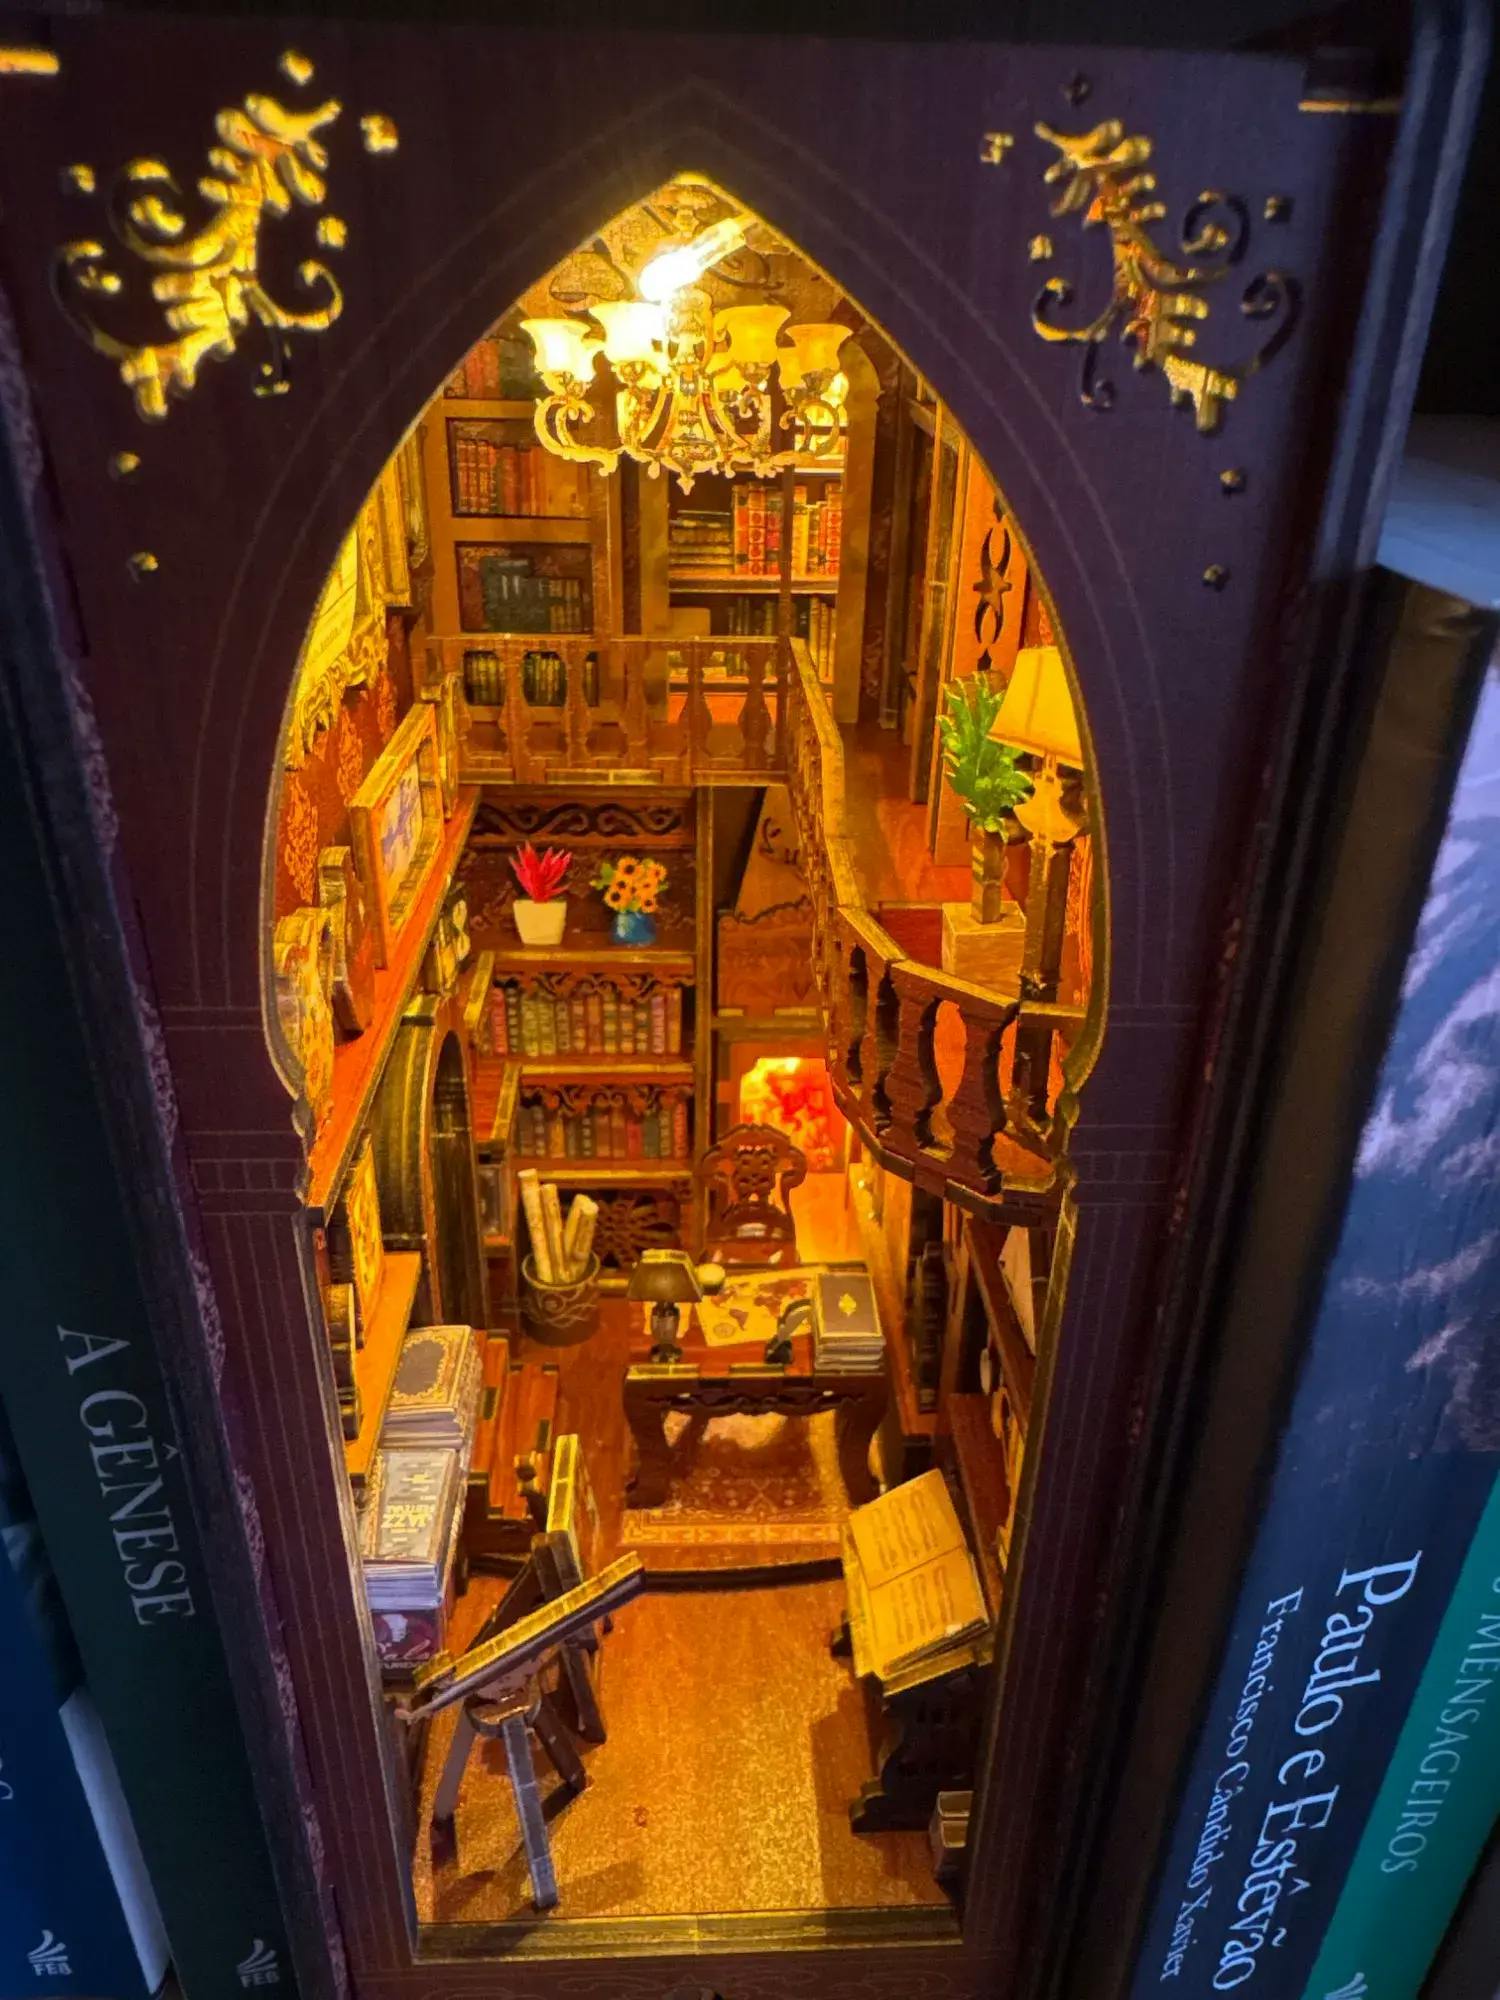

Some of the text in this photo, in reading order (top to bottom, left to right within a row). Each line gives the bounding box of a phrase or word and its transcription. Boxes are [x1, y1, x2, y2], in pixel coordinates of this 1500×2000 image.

[57, 1324, 194, 1625] A GÊNESE
[1226, 1586, 1303, 1759] Francisco
[1380, 1612, 1500, 1875] MENSAGEIROS
[1212, 1550, 1423, 1992] Paulo e Estêvão
[33, 1962, 72, 1976] FEB
[240, 1970, 280, 1988] FEB
[1160, 1886, 1212, 1981] Xavier
